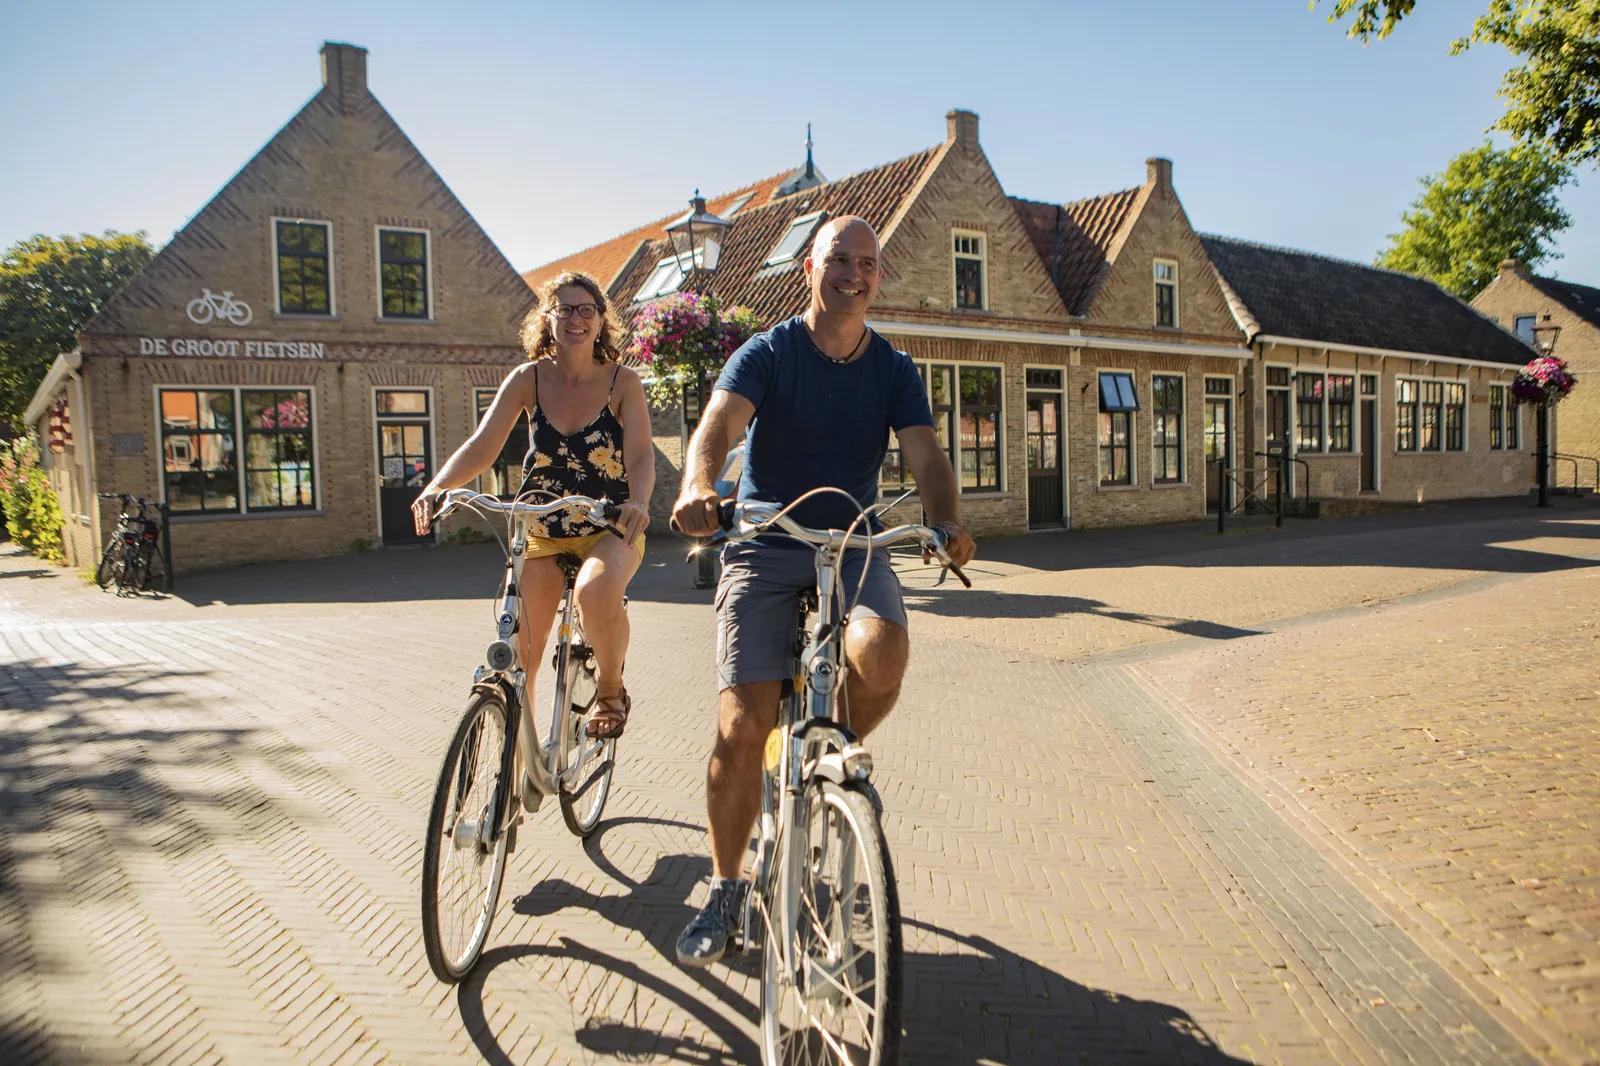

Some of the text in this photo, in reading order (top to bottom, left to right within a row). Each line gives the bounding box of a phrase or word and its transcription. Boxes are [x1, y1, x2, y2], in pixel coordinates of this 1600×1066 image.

[139, 337, 324, 359] DE GROOT FIETSEN
